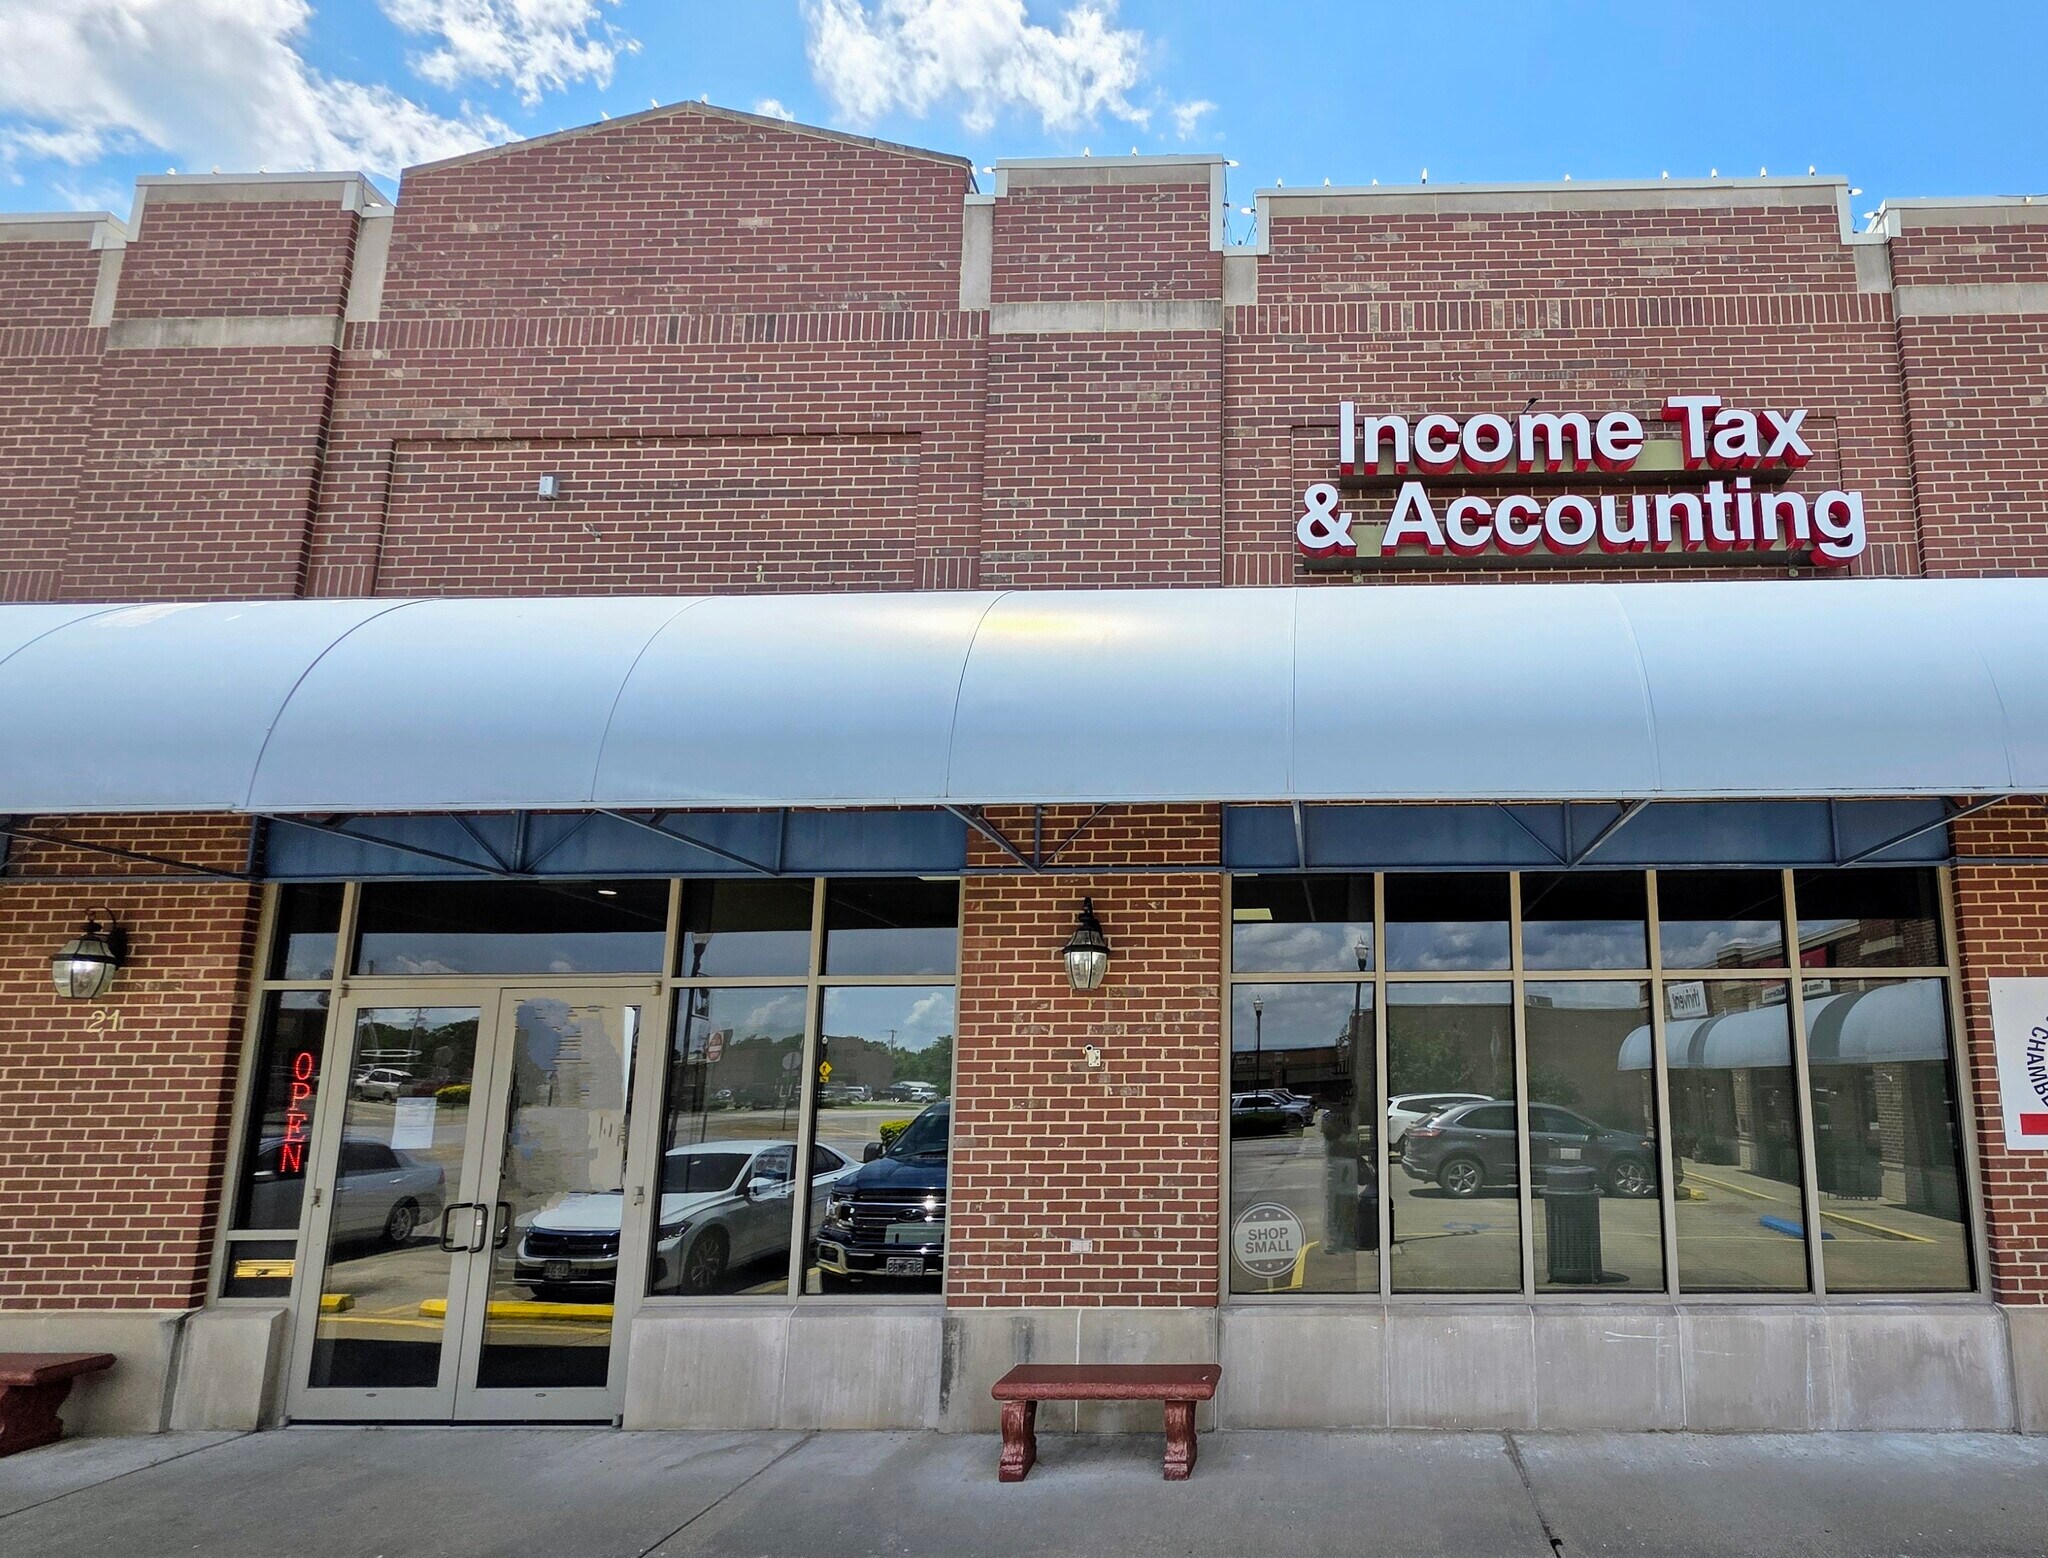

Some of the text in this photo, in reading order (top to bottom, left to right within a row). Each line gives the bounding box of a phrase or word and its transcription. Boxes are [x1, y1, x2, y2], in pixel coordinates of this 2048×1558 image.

[1339, 395, 1812, 470] Income Tax
[1295, 477, 1866, 562] & Accounting
[86, 1009, 120, 1033] 21
[2026, 1026, 2048, 1107] CHAMB
[280, 1052, 313, 1173] OPEN
[1245, 1240, 1294, 1254] SMALL
[1248, 1227, 1288, 1241] SHOP
